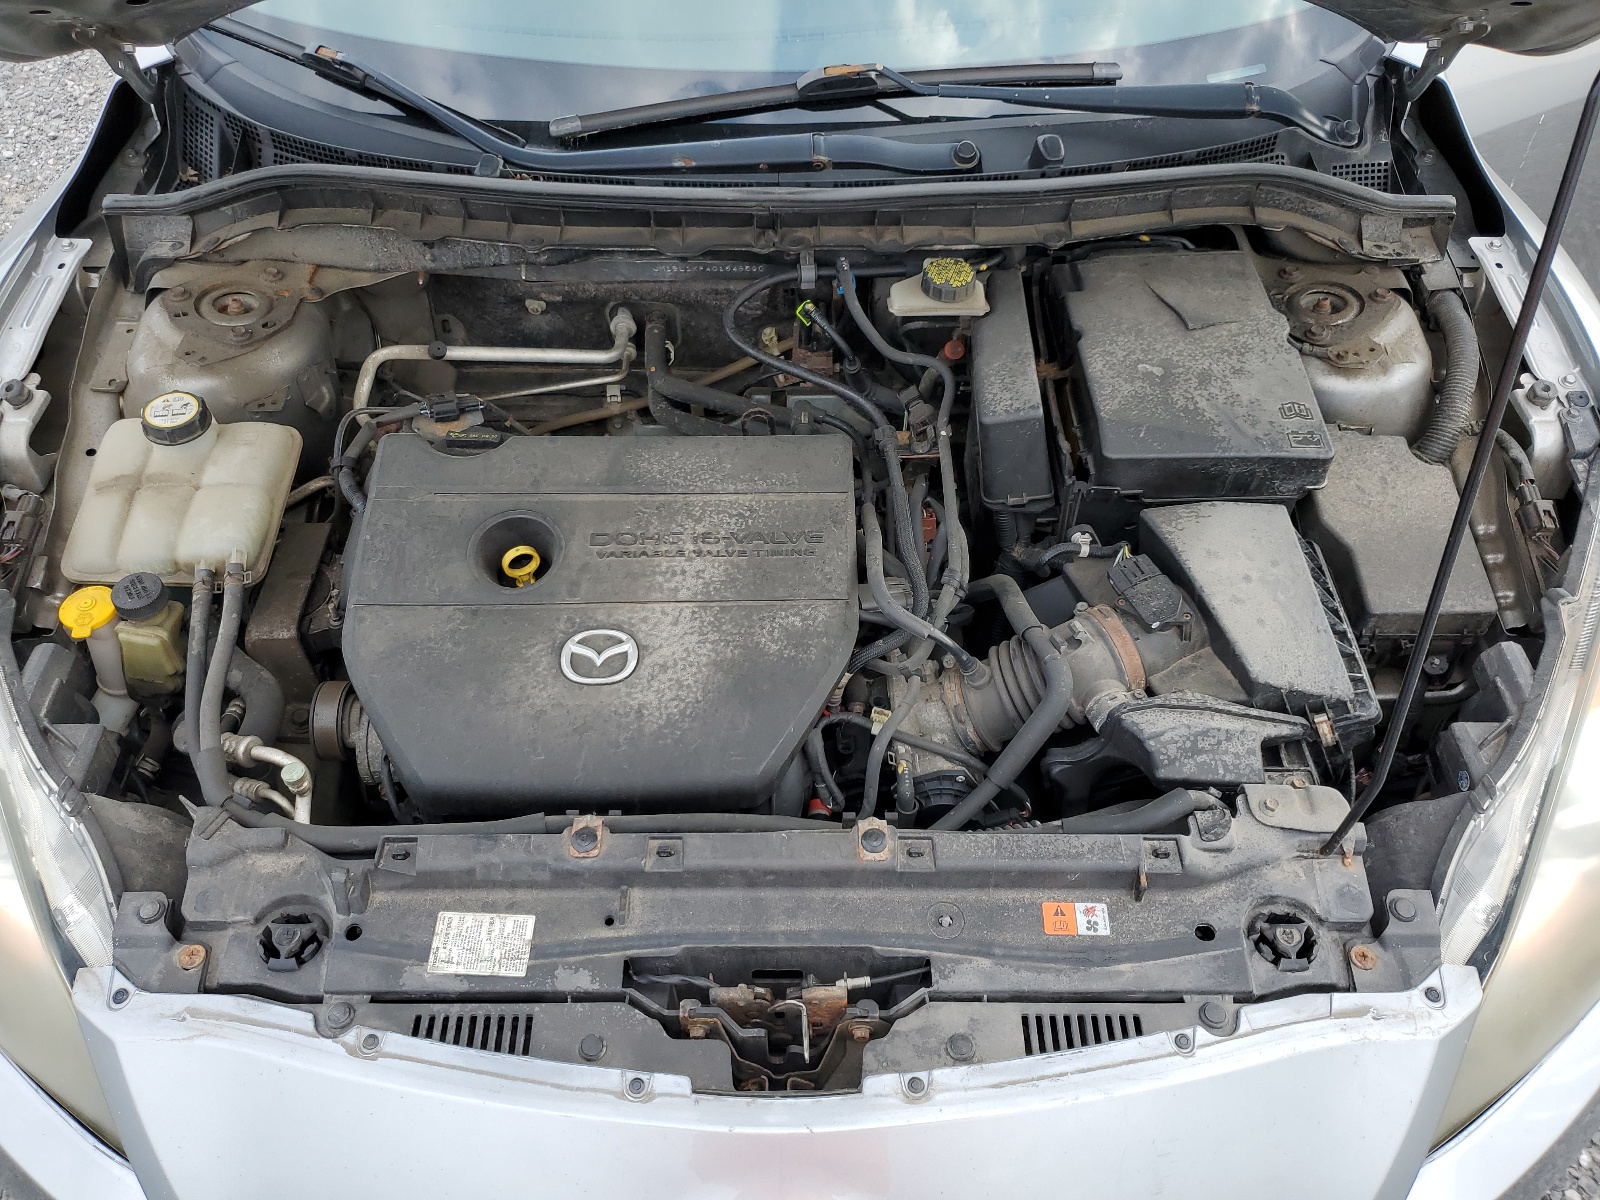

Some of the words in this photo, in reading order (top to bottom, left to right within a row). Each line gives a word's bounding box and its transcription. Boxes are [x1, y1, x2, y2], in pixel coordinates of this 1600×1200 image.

[589, 532, 684, 547] DOHC
[596, 549, 687, 560] VARIABLE
[692, 549, 749, 558] VALVE
[752, 548, 819, 558] TIMING
